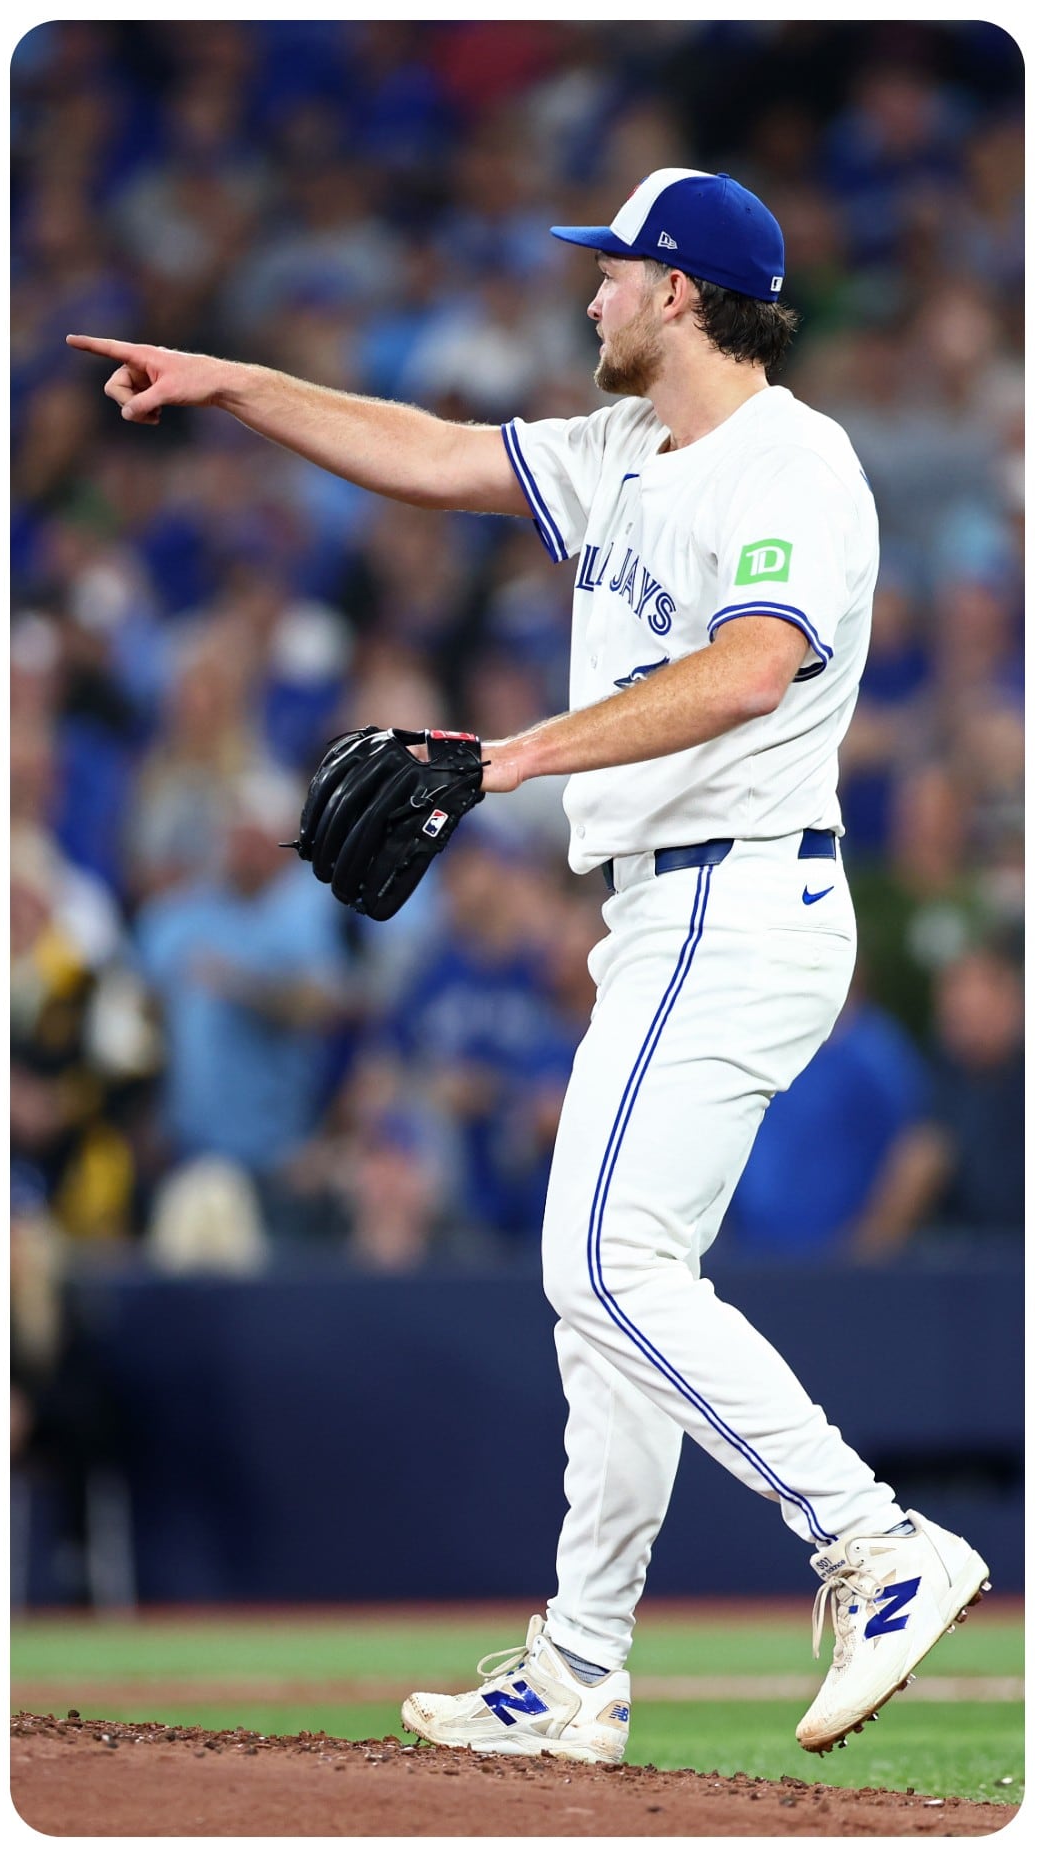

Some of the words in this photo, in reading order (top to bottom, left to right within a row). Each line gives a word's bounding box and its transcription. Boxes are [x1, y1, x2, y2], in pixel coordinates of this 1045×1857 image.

[745, 546, 786, 577] TD
[609, 547, 677, 636] JAYS
[481, 1679, 549, 1727] N
